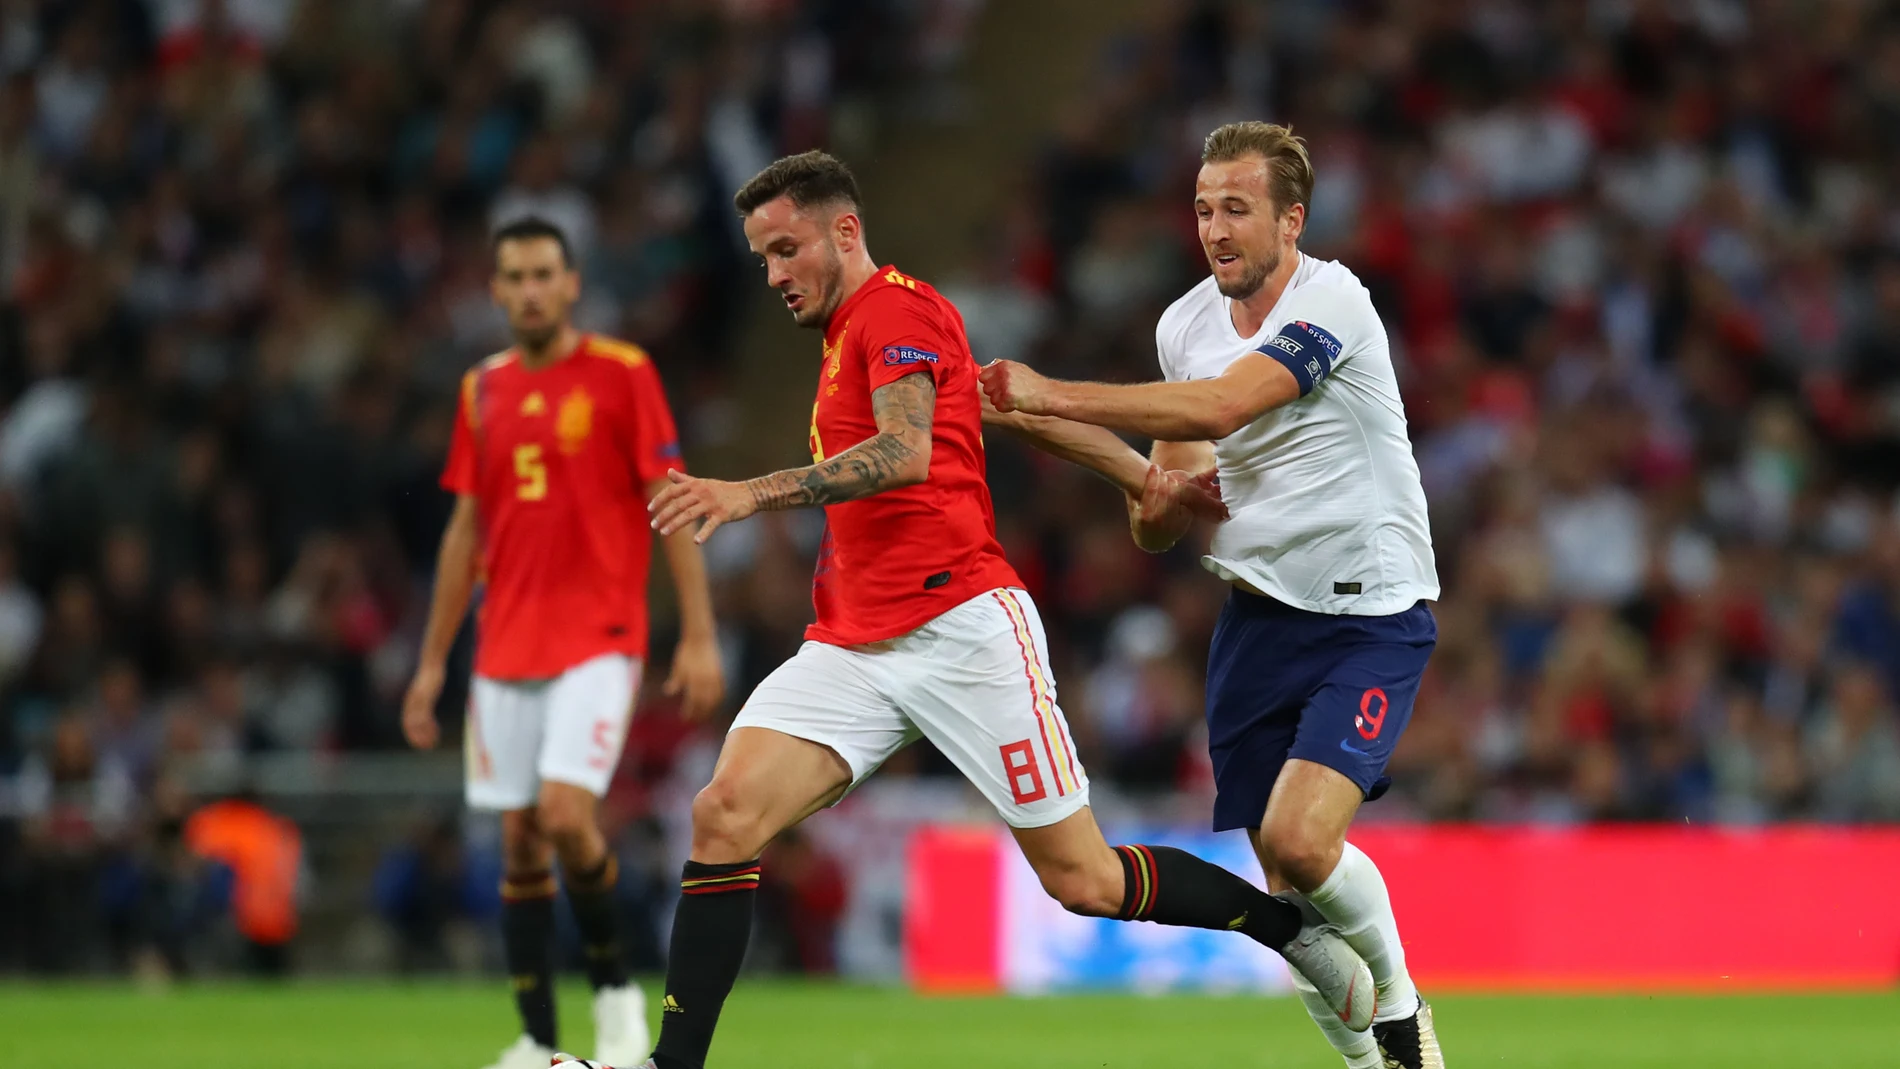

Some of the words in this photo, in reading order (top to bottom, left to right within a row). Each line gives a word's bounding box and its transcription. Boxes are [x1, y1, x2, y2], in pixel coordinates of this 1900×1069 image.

[1272, 337, 1302, 354] SPECT
[514, 444, 547, 500] 5
[1354, 687, 1389, 740] 9
[587, 719, 620, 770] 5
[999, 738, 1047, 805] 8
